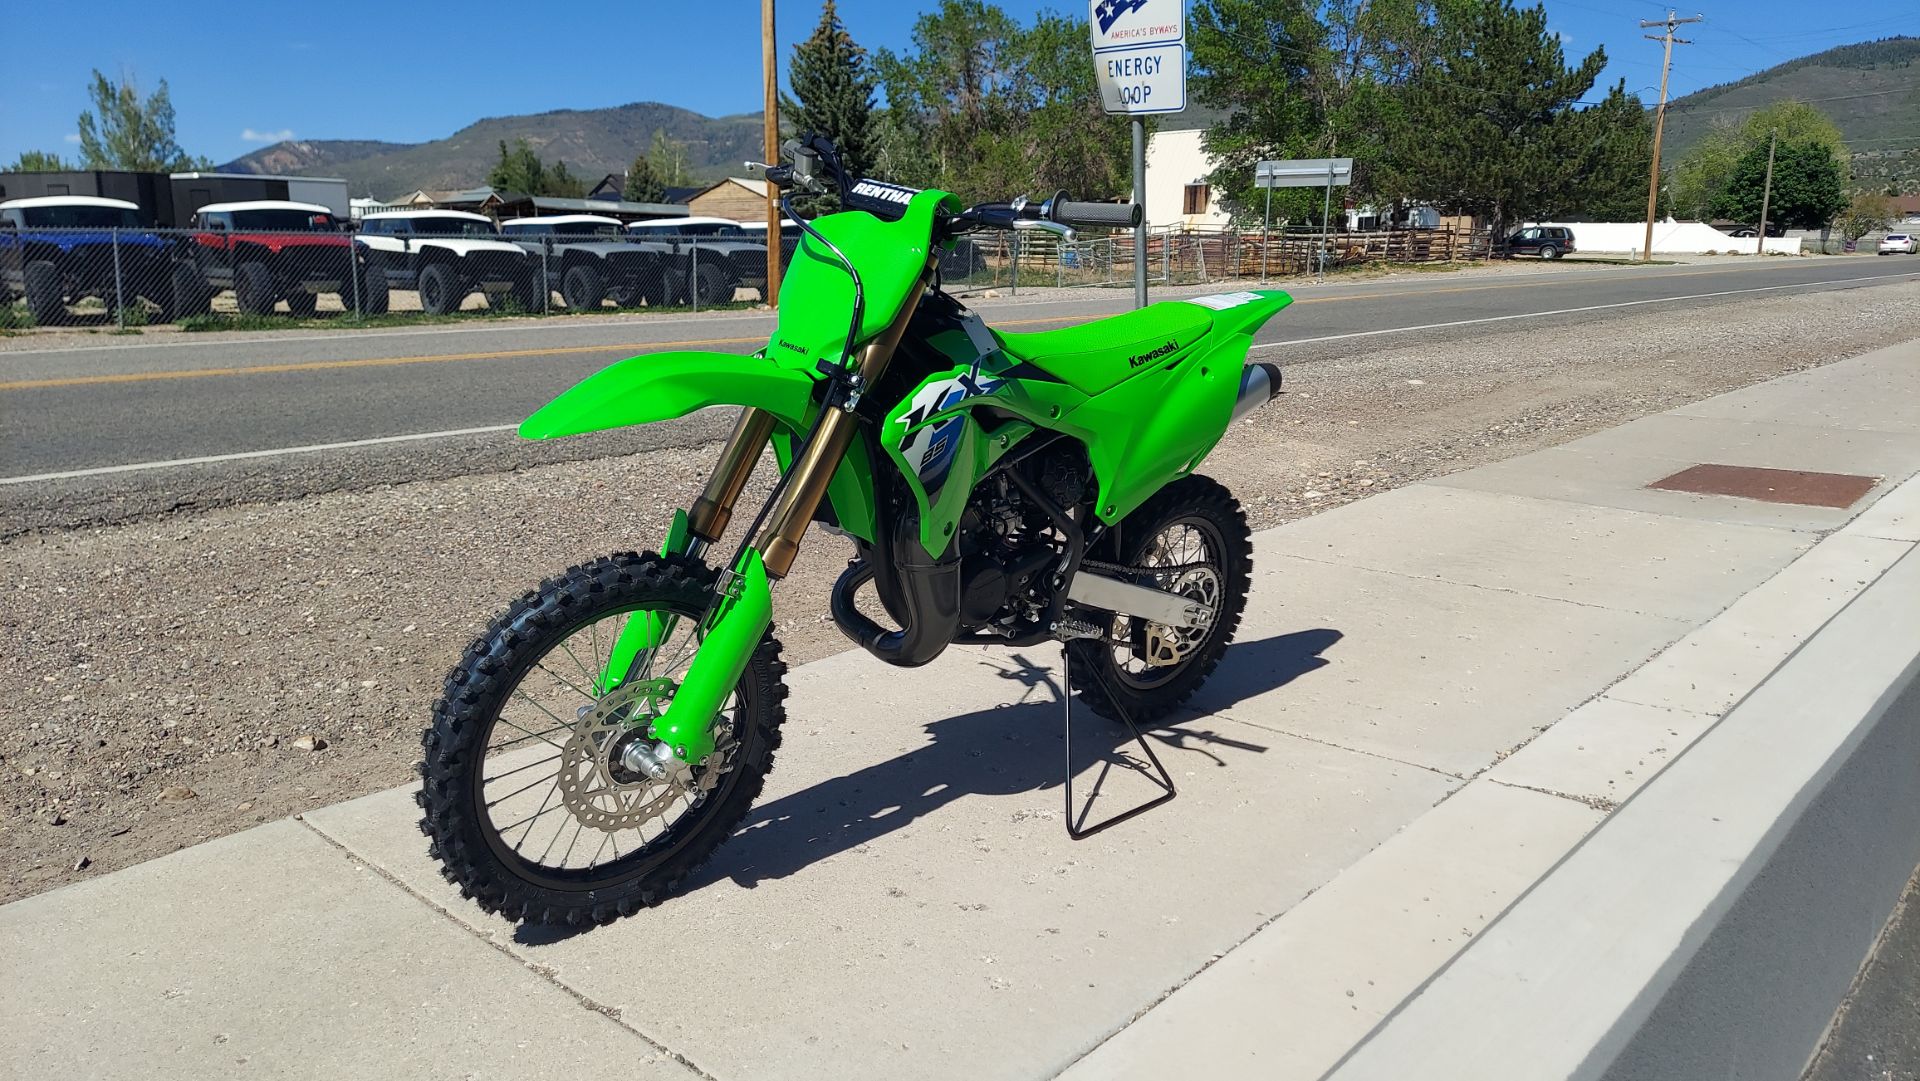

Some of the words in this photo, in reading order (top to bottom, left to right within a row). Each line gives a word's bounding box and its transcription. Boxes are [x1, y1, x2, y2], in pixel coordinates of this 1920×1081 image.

[1111, 28, 1147, 40] AMERICA'S
[1149, 25, 1178, 36] BYWAYS
[1107, 56, 1162, 78] ENERGY
[779, 339, 810, 356] Kawasaki
[1128, 338, 1180, 369] Kawasaki
